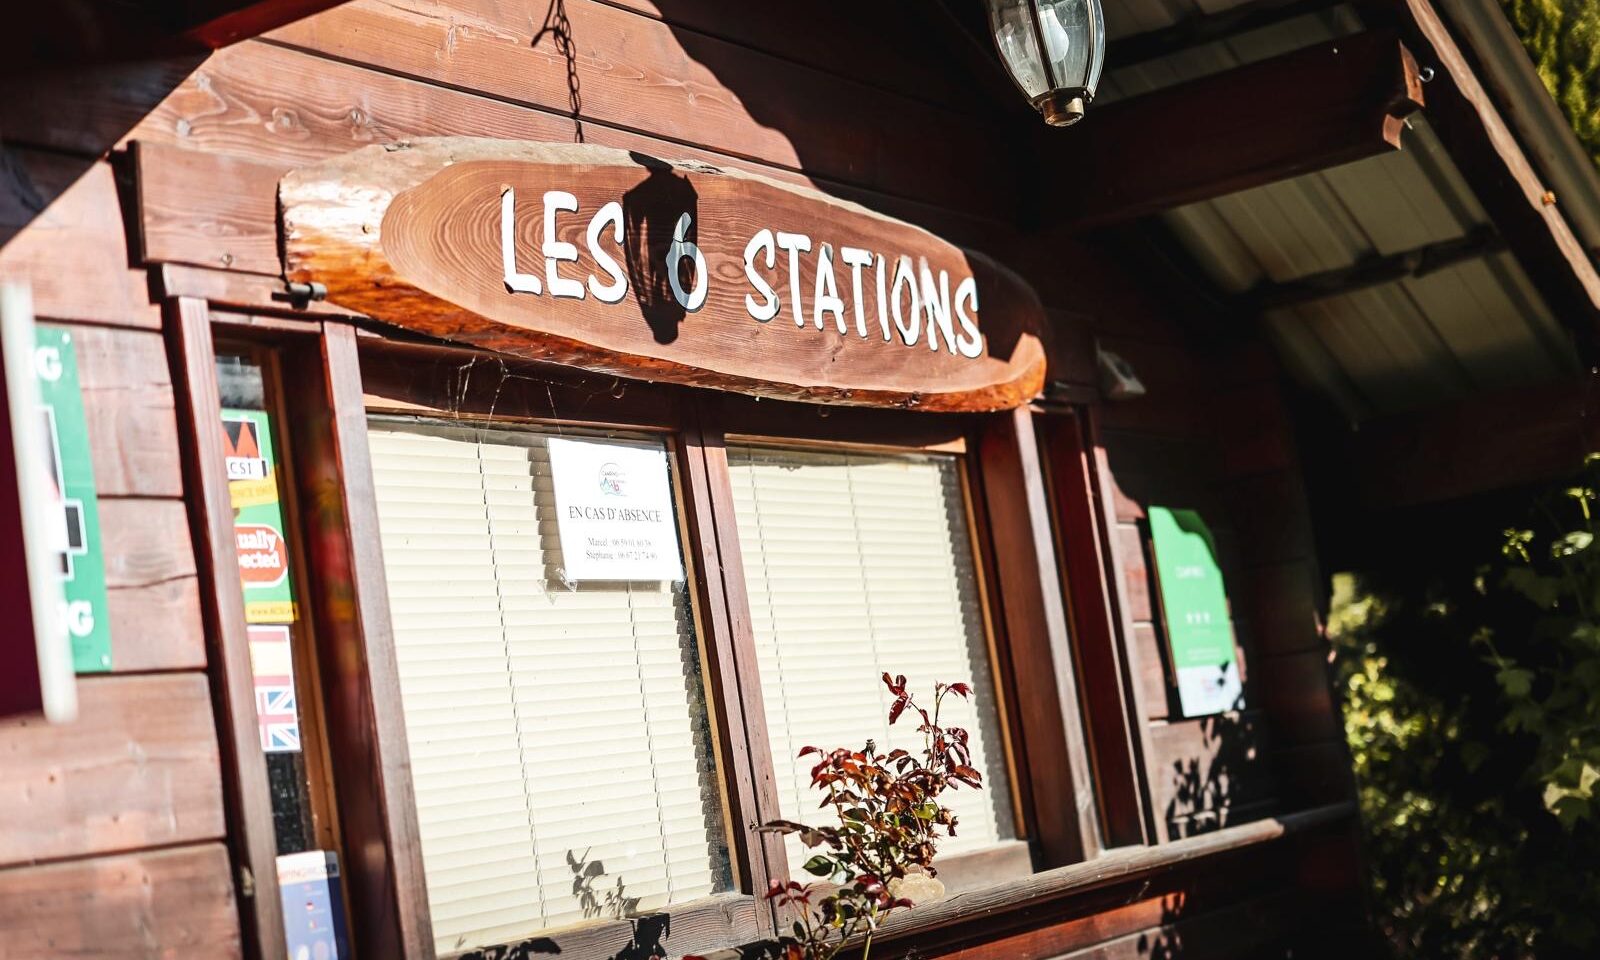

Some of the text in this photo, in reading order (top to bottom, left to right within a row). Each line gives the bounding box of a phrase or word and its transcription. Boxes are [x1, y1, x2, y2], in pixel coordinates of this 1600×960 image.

[500, 184, 984, 359] LES 6 STATIONS
[229, 461, 253, 475] CSI
[568, 505, 583, 519] EN
[585, 506, 606, 520] CAS
[236, 530, 277, 553] ually
